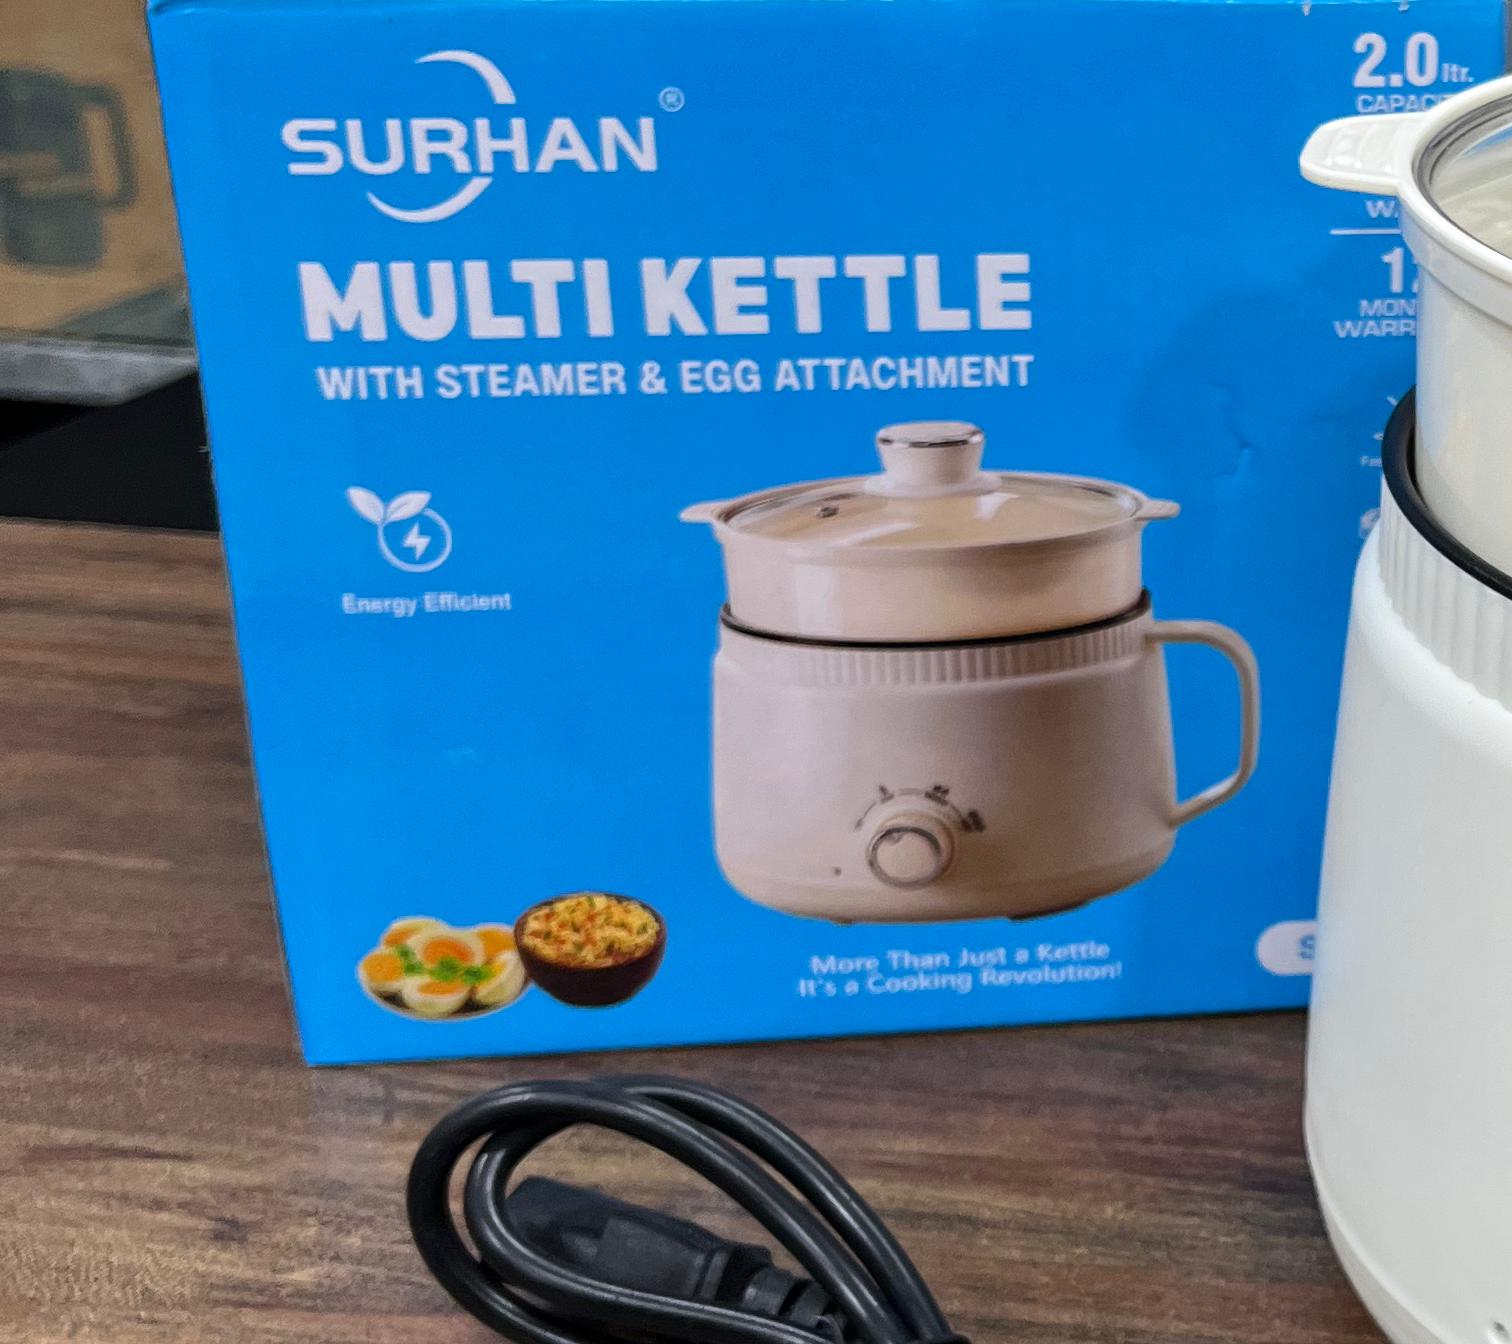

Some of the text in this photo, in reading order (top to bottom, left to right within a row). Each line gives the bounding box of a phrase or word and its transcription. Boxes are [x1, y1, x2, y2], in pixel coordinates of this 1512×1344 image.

[1353, 31, 1439, 88] 2.0
[1355, 94, 1453, 114] CAPAC
[281, 116, 659, 176] SURHAN
[297, 253, 1034, 342] MULTI KETTLE
[1359, 299, 1416, 318] MON
[1333, 320, 1417, 339] WARR
[315, 354, 1035, 401] WITH STEAMER & EGG ATTACHMENT
[341, 591, 512, 618] Energy Efficient
[809, 939, 1111, 976] More Than Just a Kettle
[798, 960, 1123, 998] It's a Cooking Revolution!
